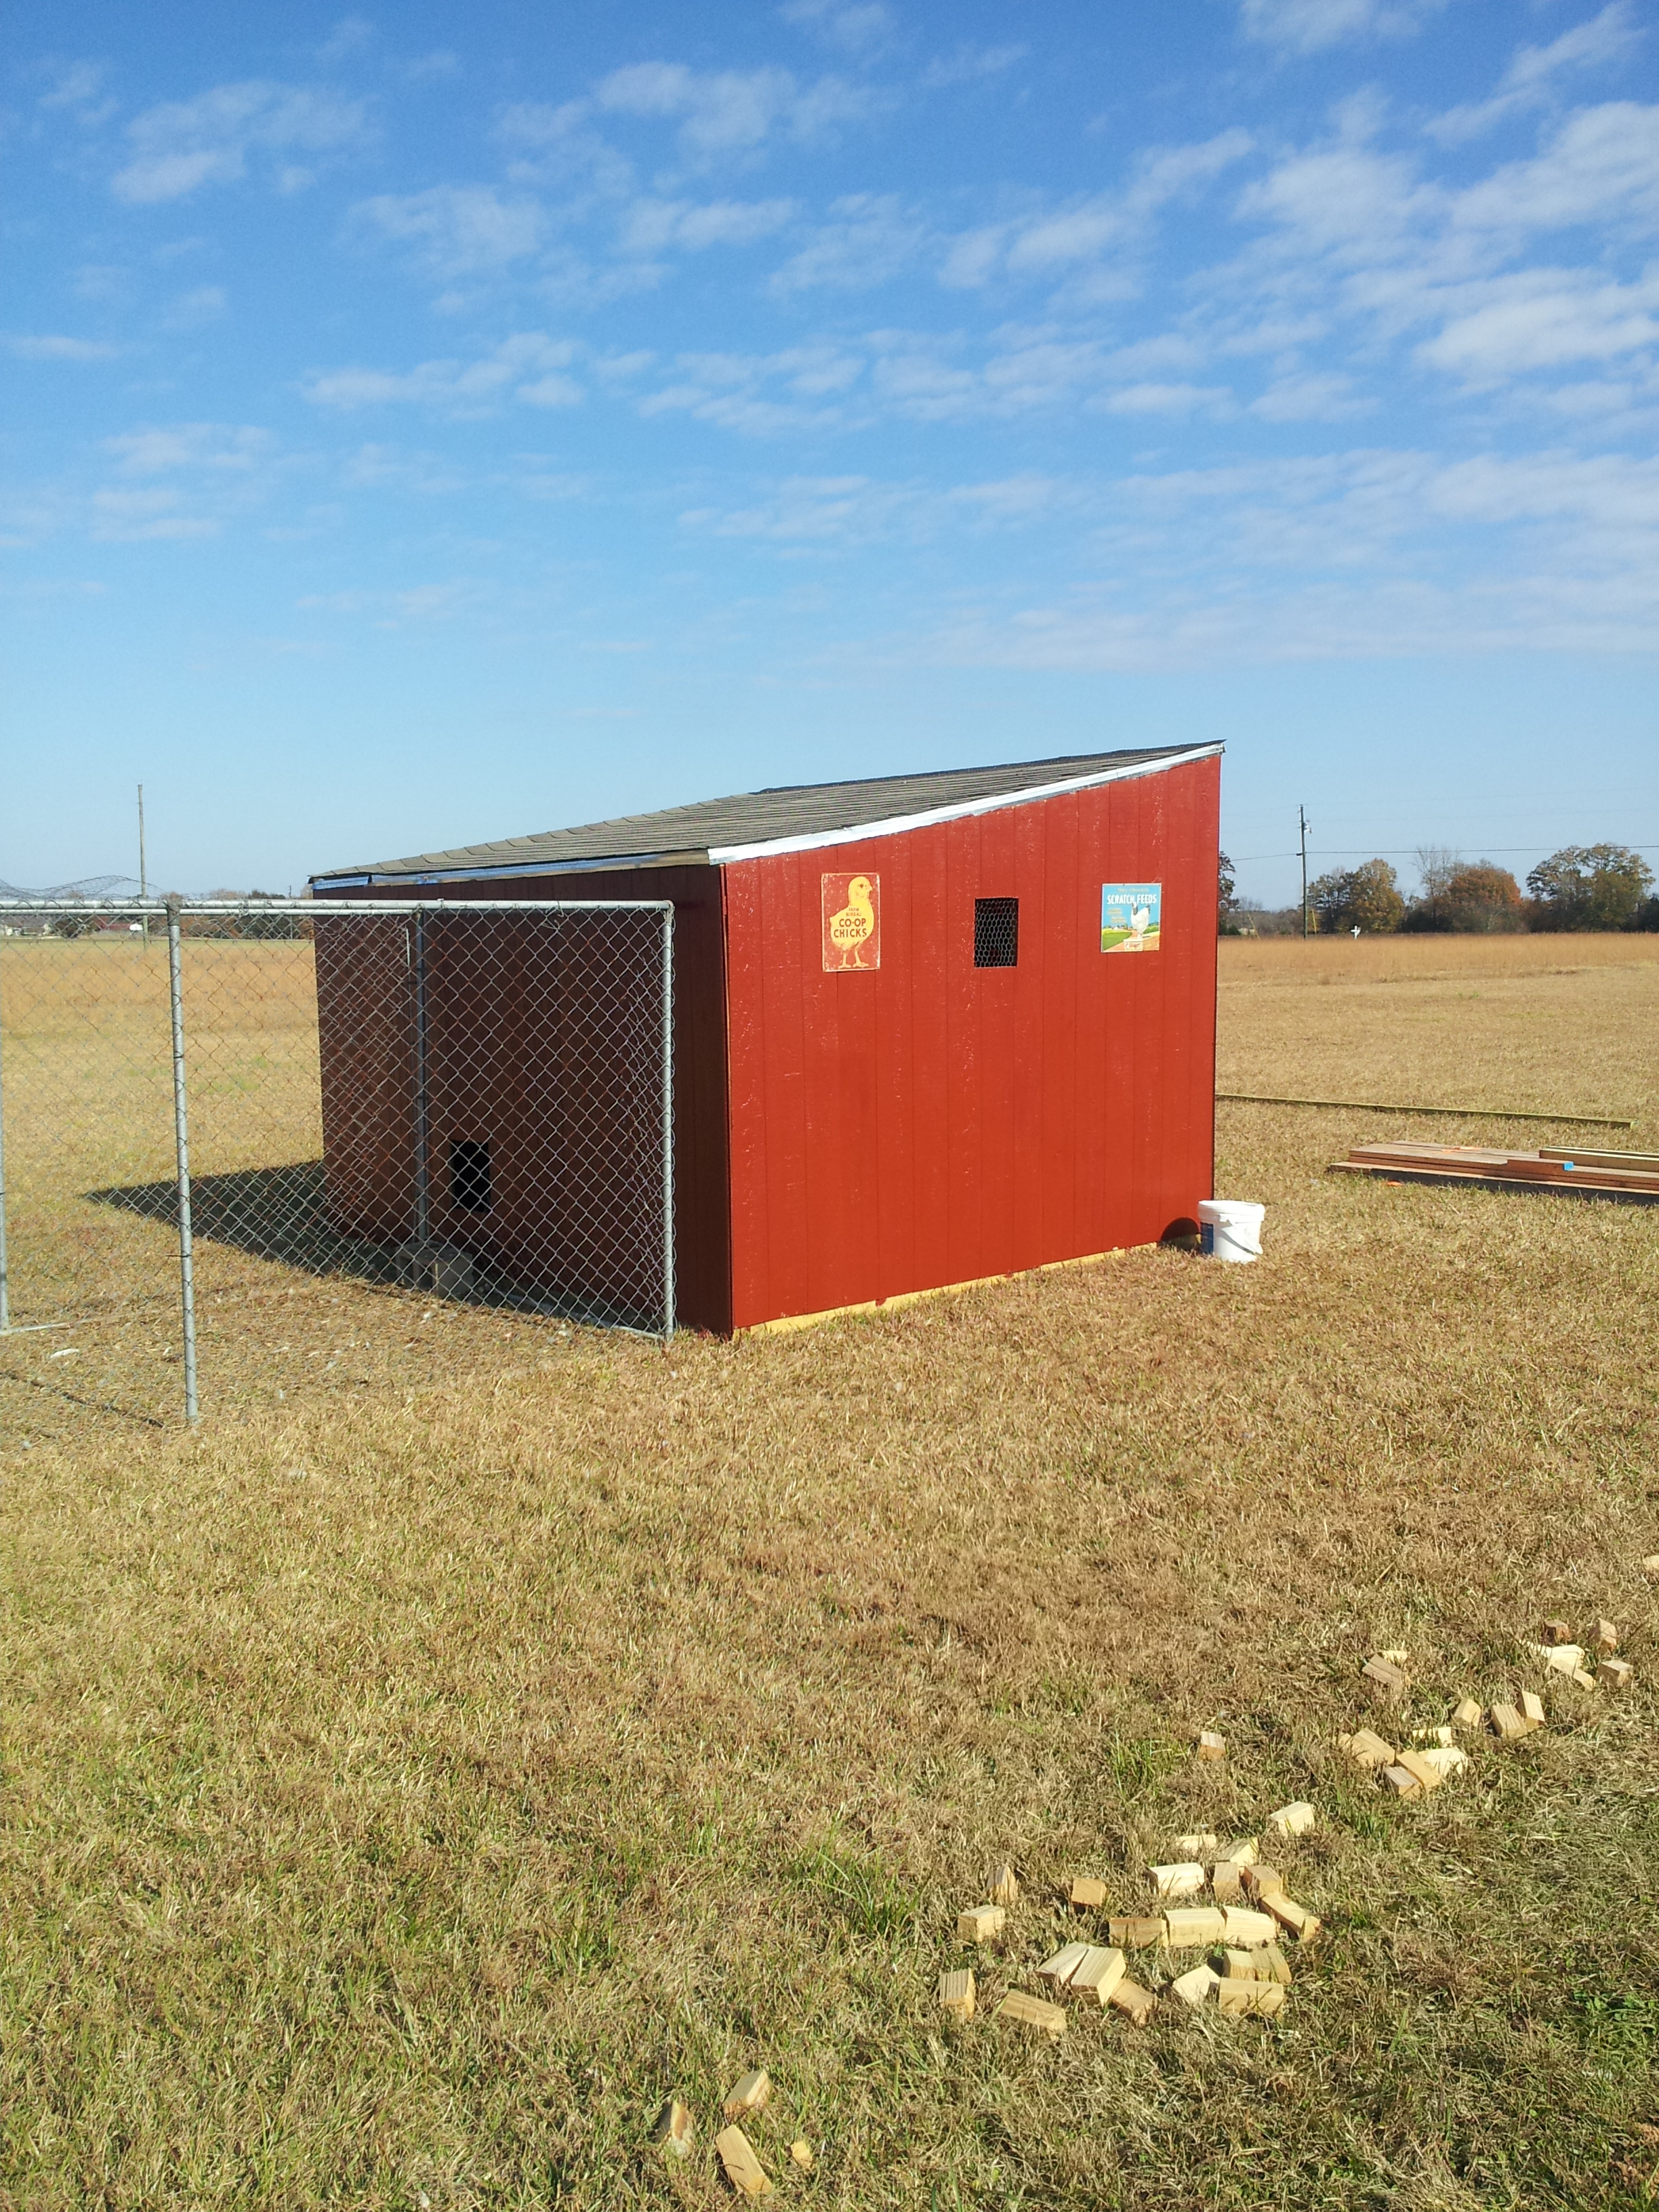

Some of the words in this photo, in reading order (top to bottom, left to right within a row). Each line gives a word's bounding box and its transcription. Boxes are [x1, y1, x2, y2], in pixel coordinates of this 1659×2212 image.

[1107, 895, 1135, 905] SCRATCH
[1136, 894, 1157, 904] FEEDS
[834, 928, 867, 938] CHICKS
